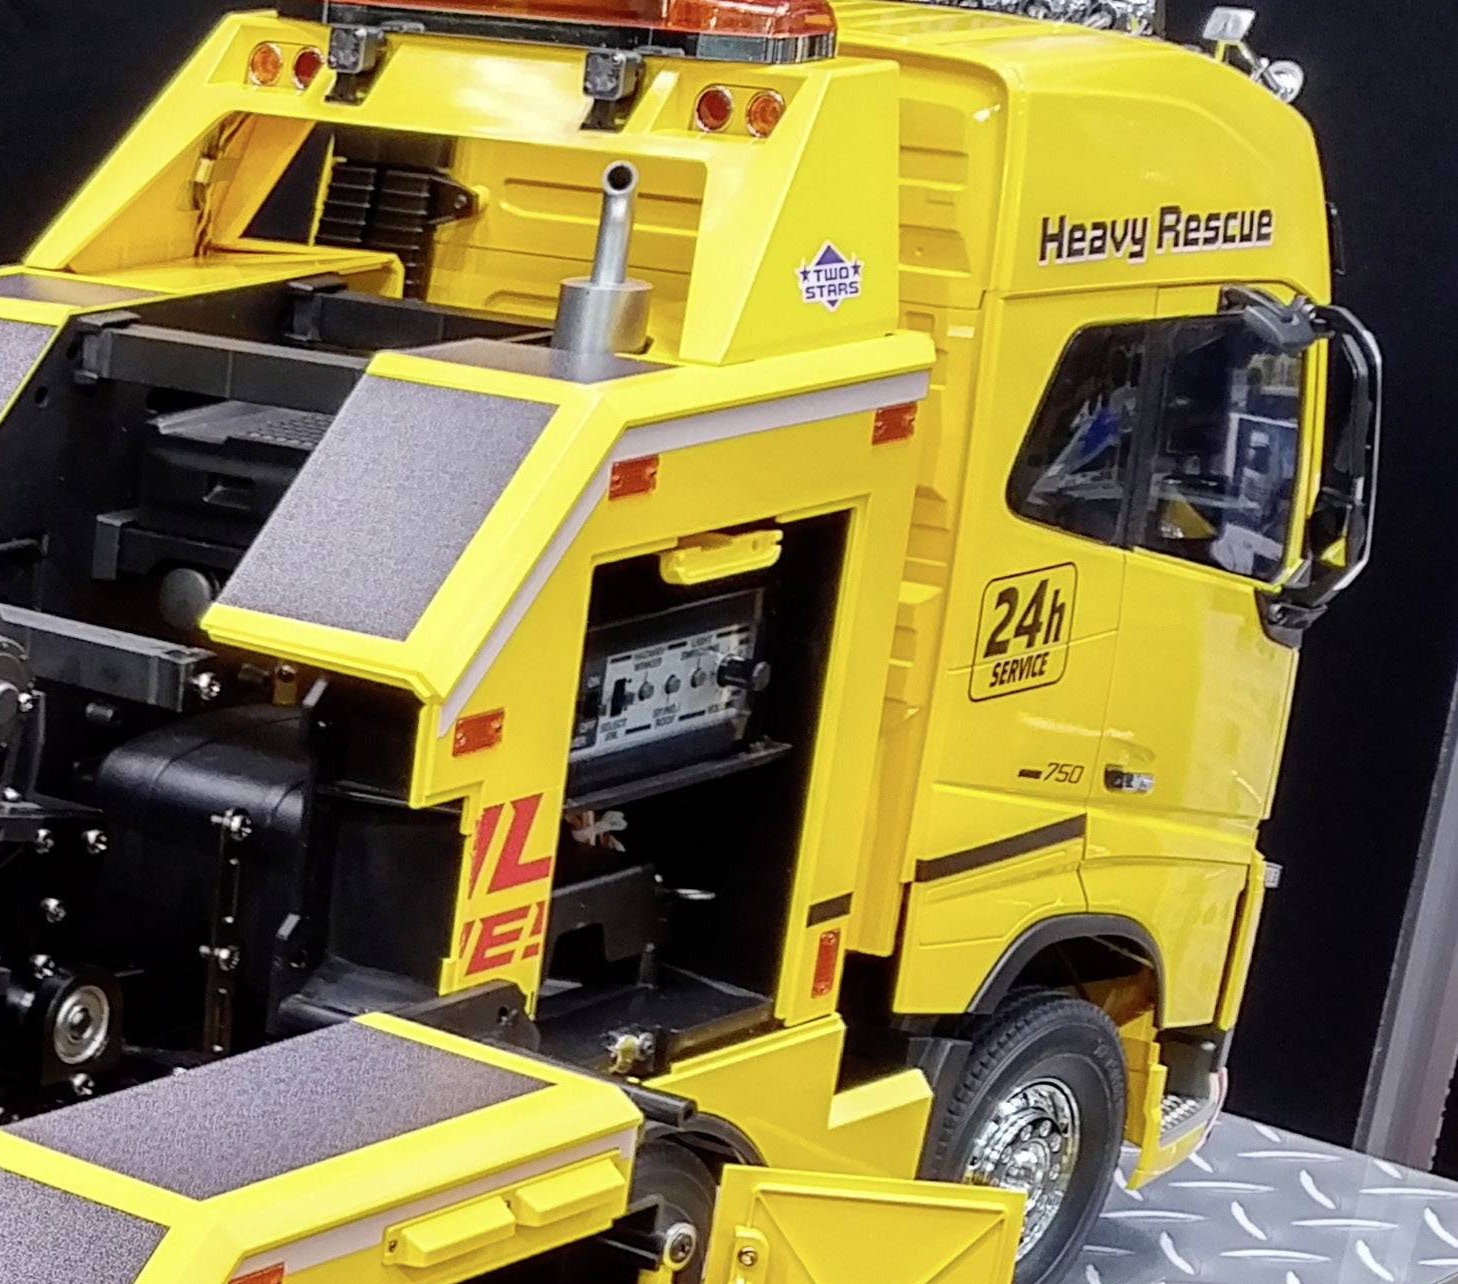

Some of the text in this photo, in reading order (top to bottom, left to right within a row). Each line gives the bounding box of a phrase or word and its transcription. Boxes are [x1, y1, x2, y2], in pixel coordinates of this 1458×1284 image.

[1038, 204, 1273, 264] Heavy Rescue
[812, 266, 850, 282] TWO
[805, 281, 860, 300] STARS
[982, 578, 1066, 659] 24h
[988, 652, 1050, 688] SERVICE
[1043, 762, 1084, 784] 750
